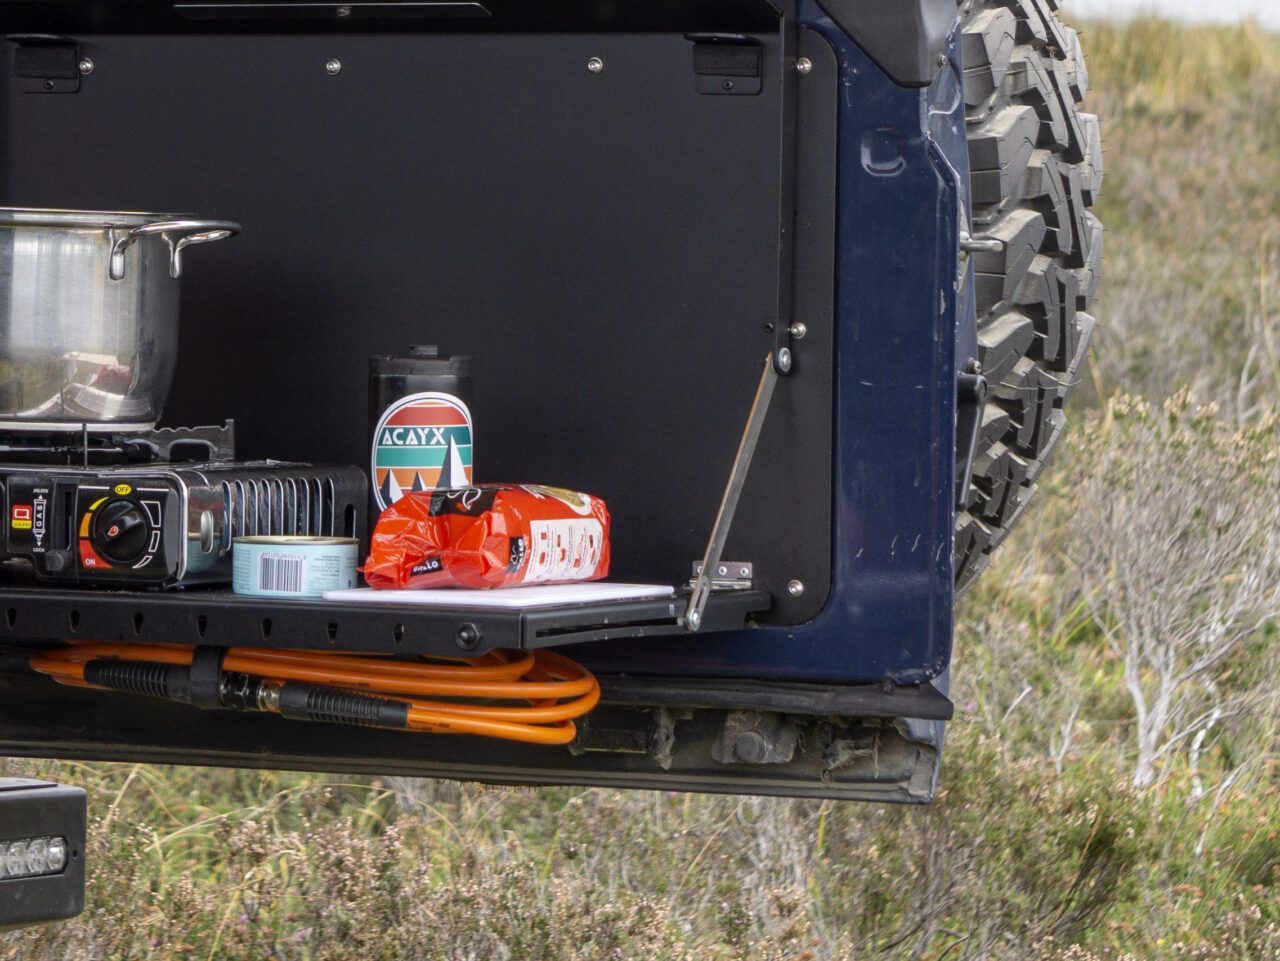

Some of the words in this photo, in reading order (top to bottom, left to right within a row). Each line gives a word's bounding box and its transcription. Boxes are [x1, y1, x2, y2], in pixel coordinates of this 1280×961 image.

[382, 427, 447, 446] ACAYX
[116, 486, 131, 494] OFF
[85, 558, 96, 566] ON
